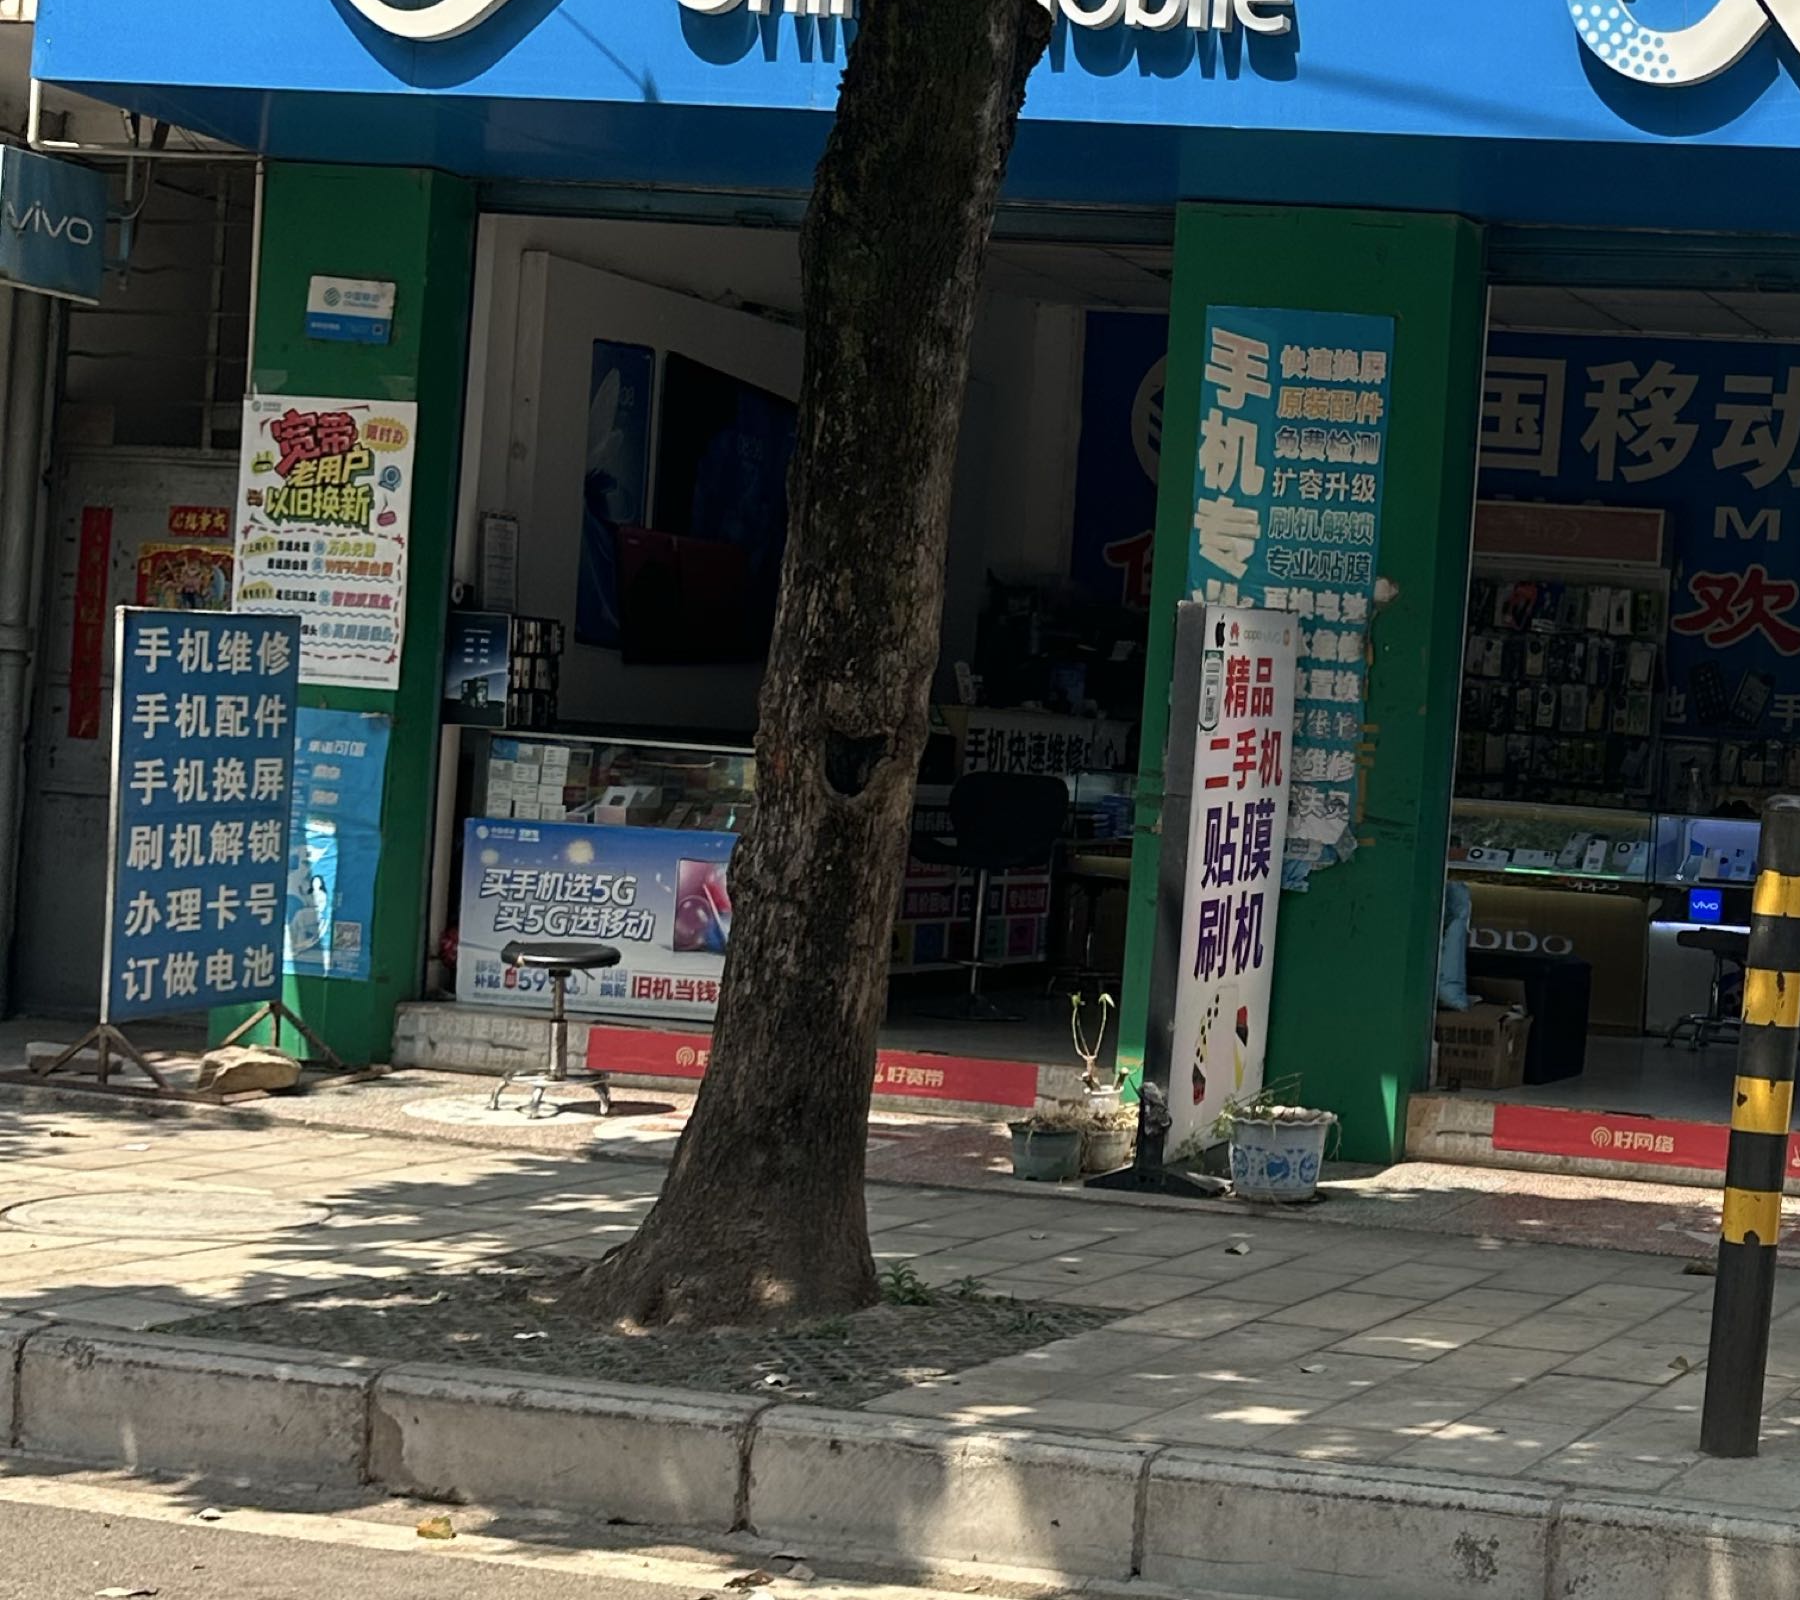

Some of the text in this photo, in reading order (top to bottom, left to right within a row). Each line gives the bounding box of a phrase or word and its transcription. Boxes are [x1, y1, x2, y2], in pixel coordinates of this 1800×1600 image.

[6, 200, 93, 245] vivo
[1278, 344, 1388, 385] 快速换屏
[1276, 385, 1385, 426] 原装配件
[270, 408, 358, 480] 宽带
[1273, 425, 1382, 465] 免费检测
[286, 444, 371, 486] 老用户
[1271, 466, 1376, 504] 扩容升级
[266, 485, 371, 526] 以旧换新
[1267, 505, 1376, 545] 刷机解锁
[1265, 547, 1373, 585] 专业贴膜
[134, 626, 292, 676] 手机维修
[1224, 655, 1274, 719] 精品
[132, 693, 288, 740] 手机配件
[1204, 727, 1283, 791] 二手机
[130, 757, 285, 806] 手机换屏
[126, 819, 282, 871] 刷机解锁
[1200, 798, 1277, 890] 贴膜
[480, 867, 638, 906] 买手机选5G
[1692, 900, 1720, 912] vivo
[124, 882, 279, 937] 办理卡号
[494, 901, 656, 941] 买5G选移动
[1193, 890, 1264, 983] 刷机
[121, 943, 276, 1002] 订做电池
[631, 974, 721, 1002] 旧机当钱
[886, 1066, 945, 1088] 好宽带
[1613, 1131, 1675, 1153] 好网络
